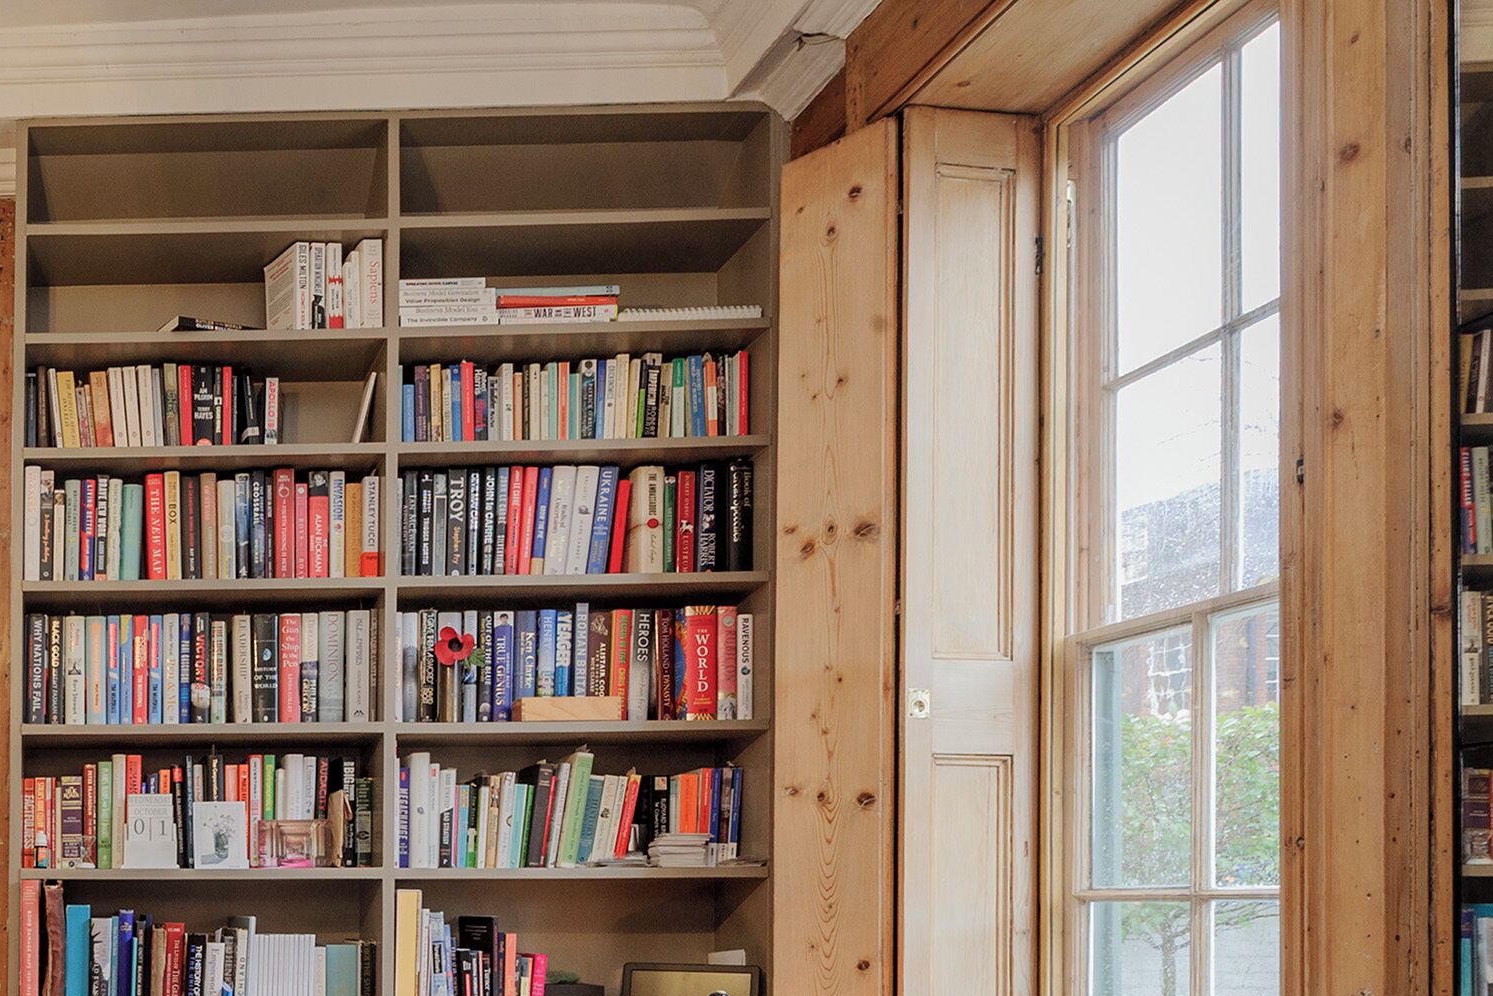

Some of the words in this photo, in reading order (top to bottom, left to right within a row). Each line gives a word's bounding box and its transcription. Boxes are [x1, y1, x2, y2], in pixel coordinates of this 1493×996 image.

[299, 245, 307, 263] GILES
[299, 265, 307, 289] MILTON
[367, 261, 379, 304] Sapiens
[533, 308, 553, 318] WAR
[573, 306, 596, 317] WEST
[194, 412, 213, 420] HAYES
[98, 478, 107, 499] BRAVE
[486, 475, 495, 501] JOHN
[649, 473, 657, 481] THE
[704, 470, 715, 512] DICTATOR
[151, 489, 160, 514] THE
[333, 479, 343, 520] INVASION
[368, 481, 376, 518] STANLEY
[450, 477, 464, 521] TROY
[597, 470, 612, 522] UKRAINE
[648, 484, 657, 516] AMBASSADORS
[744, 498, 752, 507] of
[169, 503, 177, 525] BOX
[560, 504, 568, 528] Radical
[151, 518, 161, 544] NEW
[367, 520, 375, 547] TUCCI
[453, 527, 461, 551] Stephen
[152, 549, 161, 574] MAP
[452, 553, 460, 564] Fry
[700, 534, 708, 566] HARRIS
[707, 533, 715, 565] ROBERT
[34, 620, 42, 642] WHY
[485, 634, 492, 645] OF
[525, 632, 535, 652] Ken
[544, 617, 552, 649] HENRY
[556, 614, 572, 668] YEAGER
[576, 614, 586, 656] ROMAN
[637, 614, 649, 661] HEROES
[741, 618, 750, 663] RAVENOUS
[196, 635, 206, 682] VICTORY
[239, 619, 247, 680] LEADERSHIP
[282, 644, 299, 652] Ship
[328, 614, 339, 682] DOMINION
[497, 636, 505, 664] TRUE
[662, 633, 670, 669] HOLLAND
[695, 634, 710, 692] WORLD
[33, 645, 41, 687] NATIONS
[525, 656, 534, 688] Clarke
[576, 660, 586, 697] BRITA
[496, 666, 505, 705] GENIUS
[32, 691, 41, 711] FAIL
[319, 761, 328, 810] AUDACITY
[344, 767, 355, 783] BIG
[24, 795, 34, 849] FACTFULNESS
[399, 788, 408, 839] MEGACHANGE
[659, 798, 667, 824] RUDYARD
[134, 818, 145, 835] 0
[194, 987, 200, 996] OF
